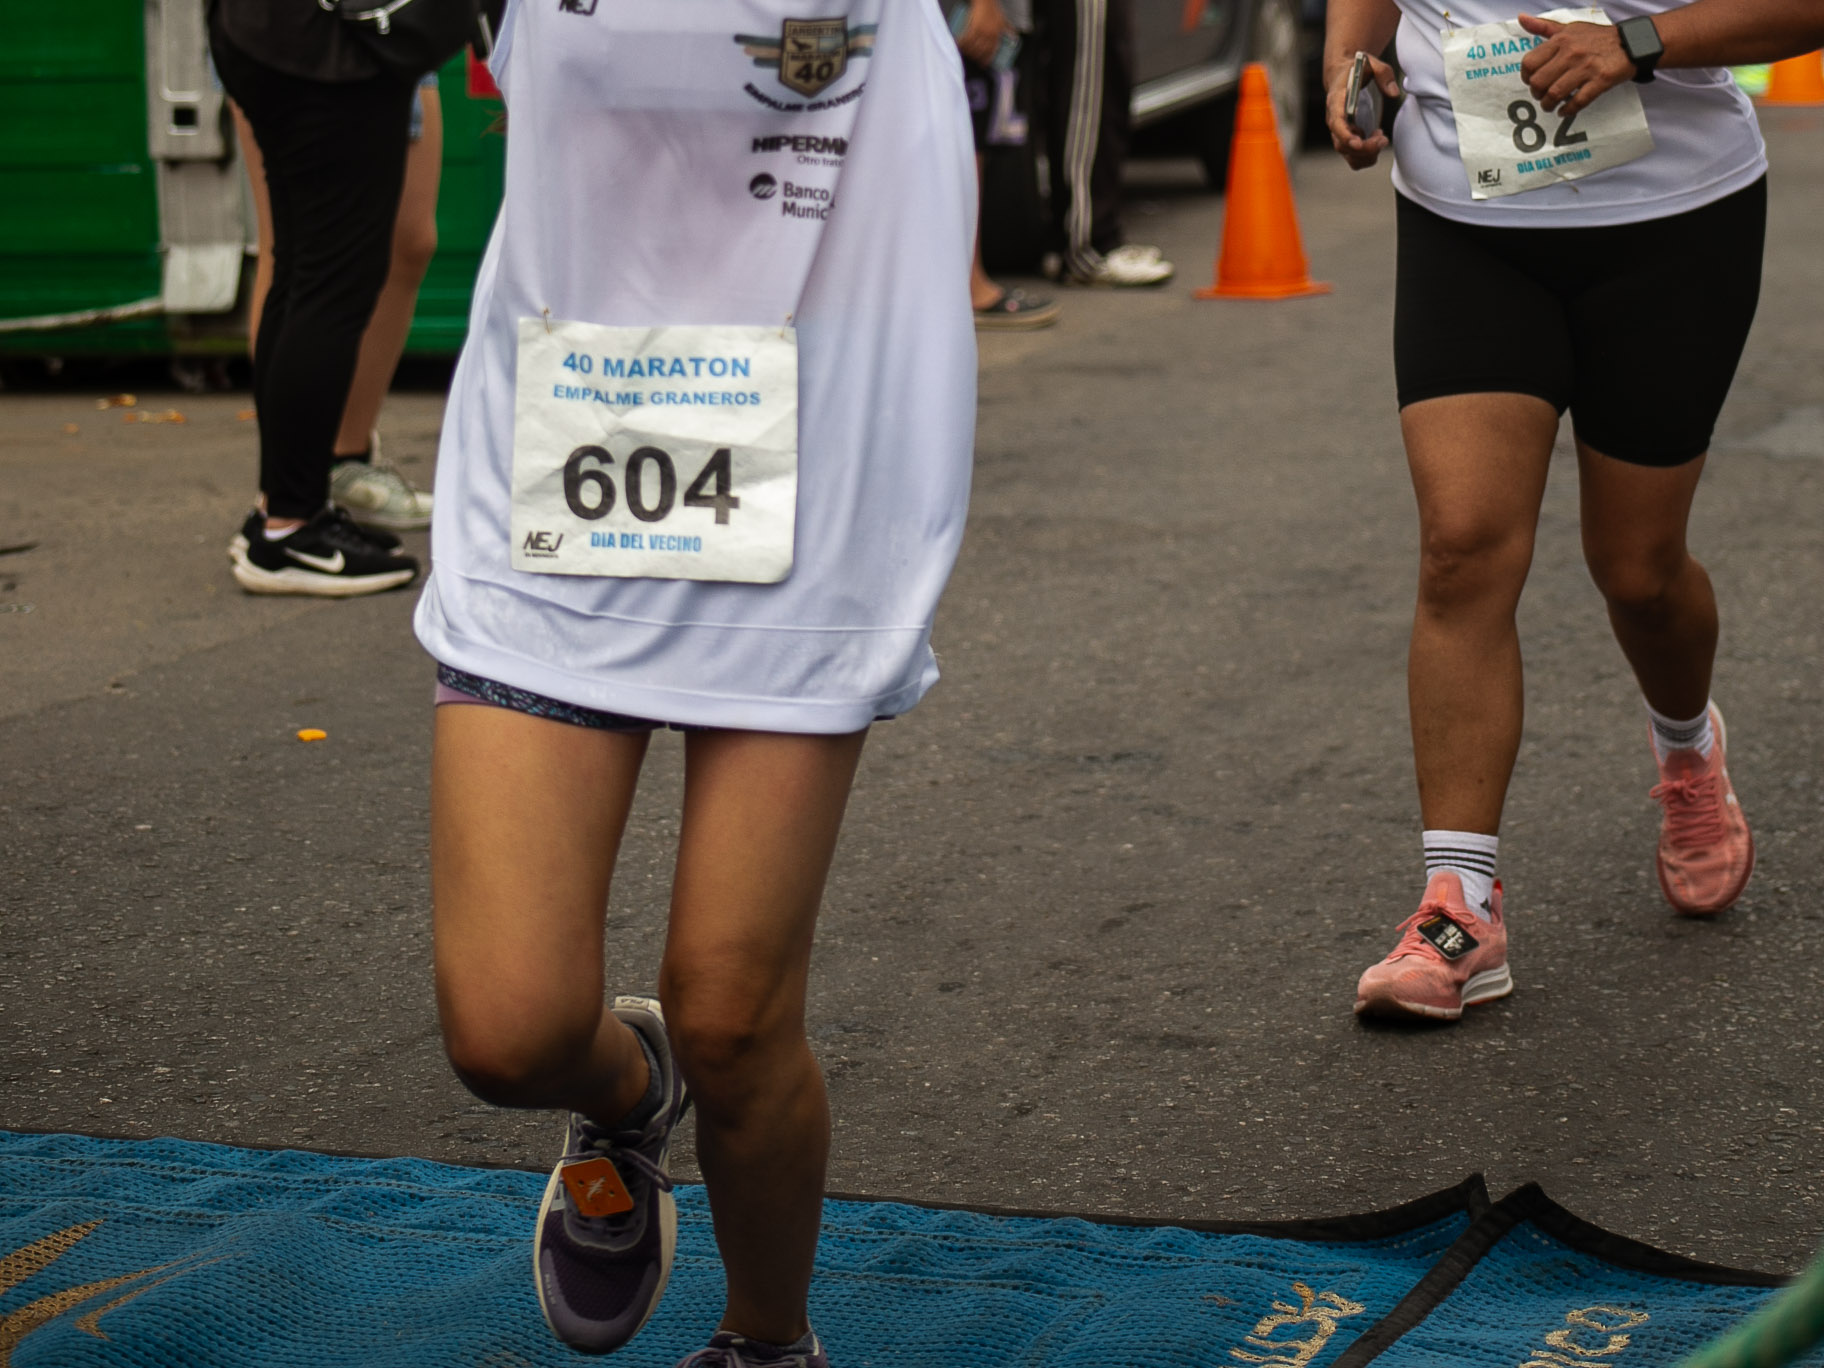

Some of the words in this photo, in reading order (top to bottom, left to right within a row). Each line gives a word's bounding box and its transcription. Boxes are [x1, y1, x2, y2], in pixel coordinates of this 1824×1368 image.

[1466, 45, 1486, 60] 40
[1491, 35, 1543, 57] MARA
[795, 61, 834, 83] 40
[1466, 63, 1521, 80] EMPALME
[1507, 99, 1588, 153] 82
[751, 135, 849, 156] HIPERM
[1536, 157, 1553, 170] DEL
[1553, 148, 1592, 165] VECINO
[1478, 169, 1500, 184] NEJ
[783, 182, 830, 201] Banco
[782, 201, 829, 221] Munic
[563, 352, 593, 374] 40
[603, 357, 750, 378] MARATON
[553, 384, 643, 405] EMPALME
[650, 391, 760, 406] GRANEROS
[563, 445, 740, 525] 604
[523, 531, 564, 552] NEJ
[590, 532, 615, 549] DIA
[620, 533, 644, 550] DEL
[650, 534, 702, 552] VECINO
